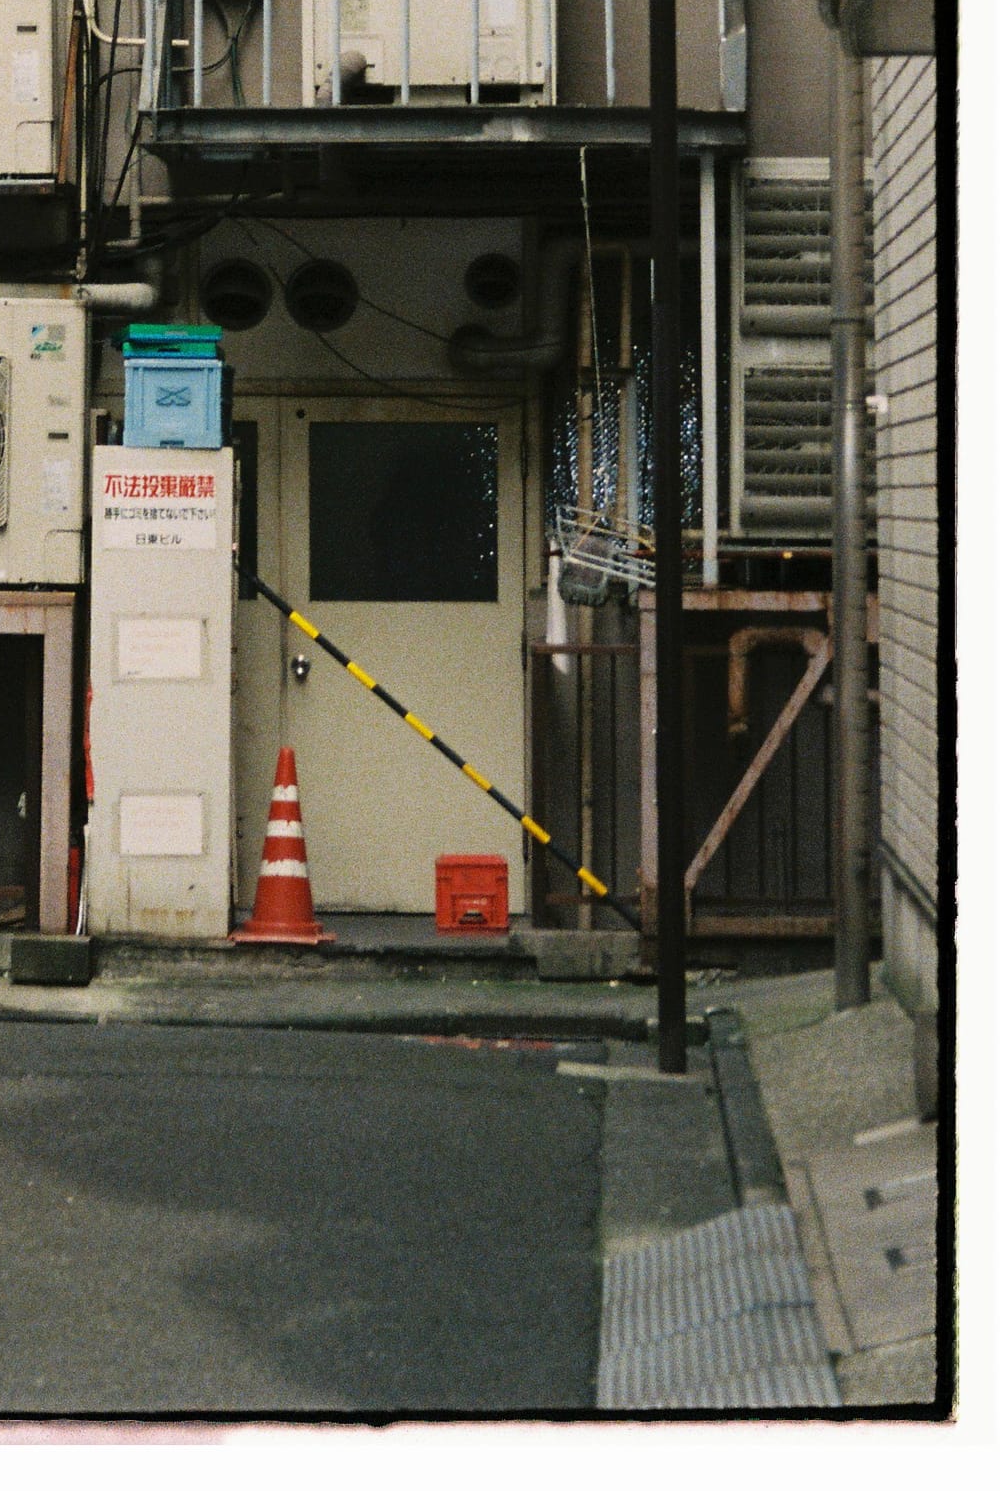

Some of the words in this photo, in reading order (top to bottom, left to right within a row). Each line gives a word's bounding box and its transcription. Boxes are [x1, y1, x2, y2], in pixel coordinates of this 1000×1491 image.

[104, 474, 215, 498] 不法投棄厳禁
